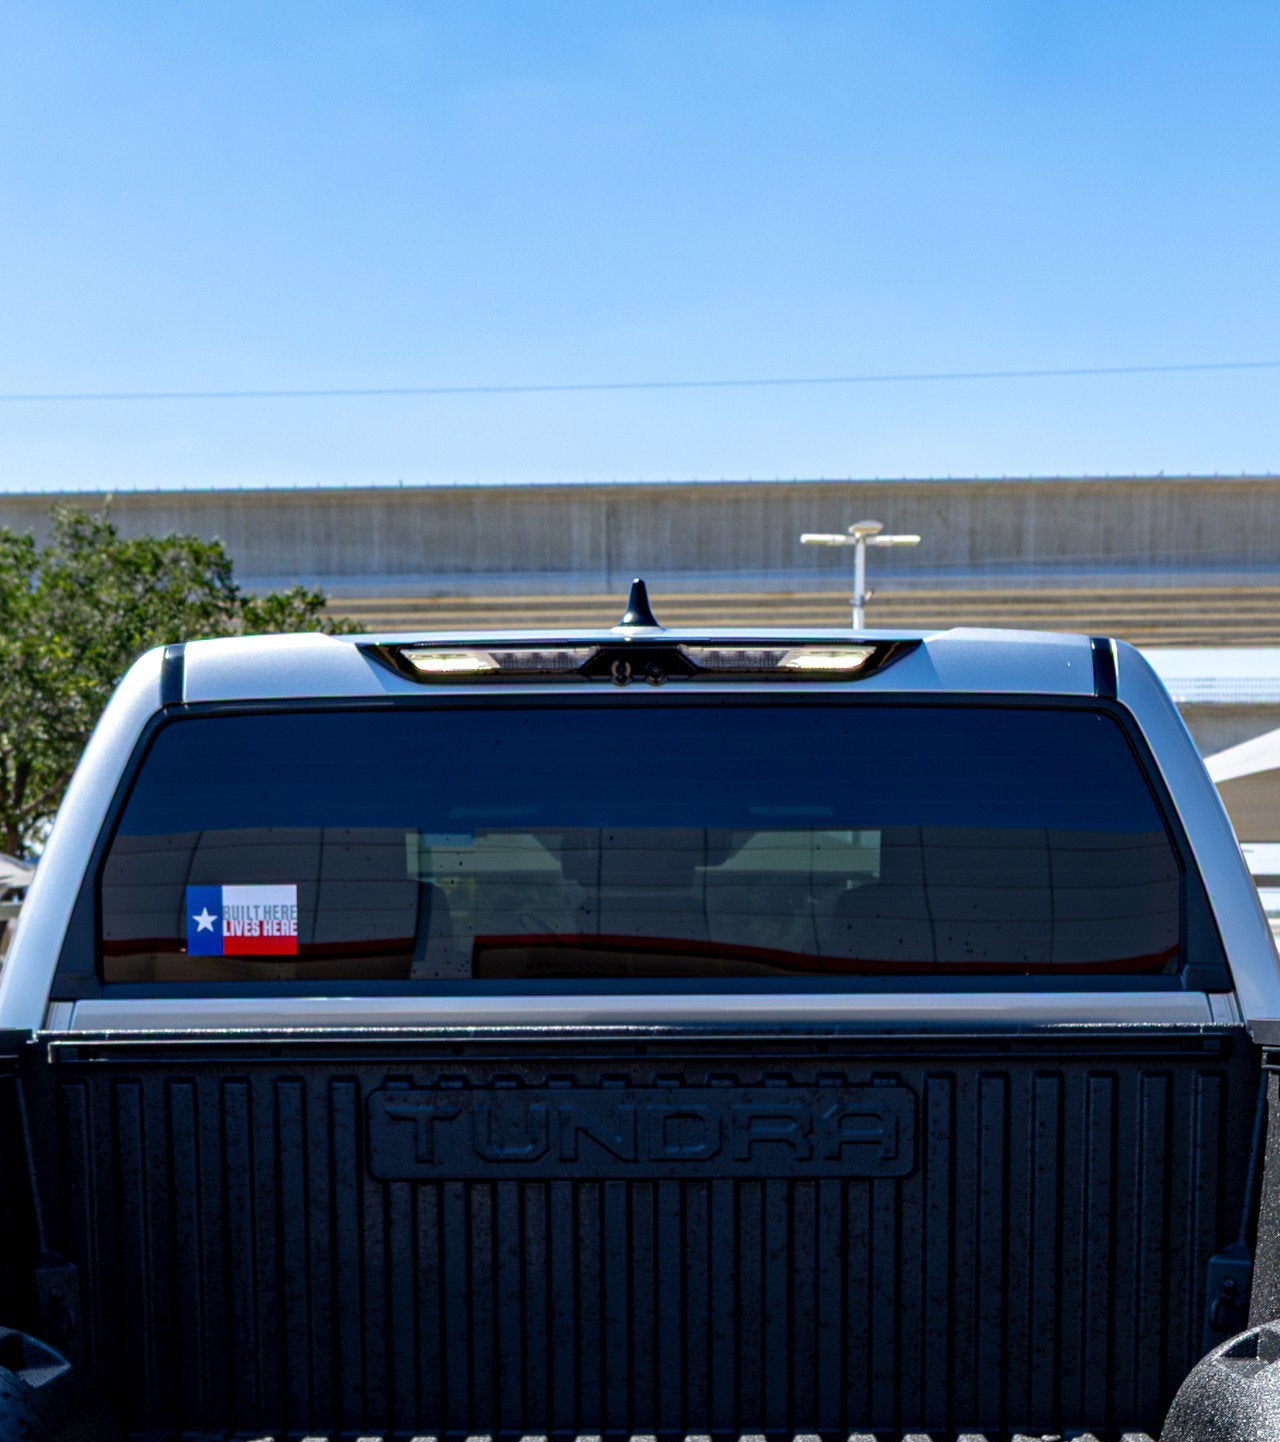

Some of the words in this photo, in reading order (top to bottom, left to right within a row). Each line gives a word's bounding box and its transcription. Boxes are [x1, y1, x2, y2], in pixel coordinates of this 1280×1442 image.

[223, 904, 261, 921] BUILT
[264, 904, 297, 920] HERE
[223, 920, 261, 937] LIVES
[264, 919, 297, 937] HERE
[383, 1103, 901, 1164] TUNDRA
